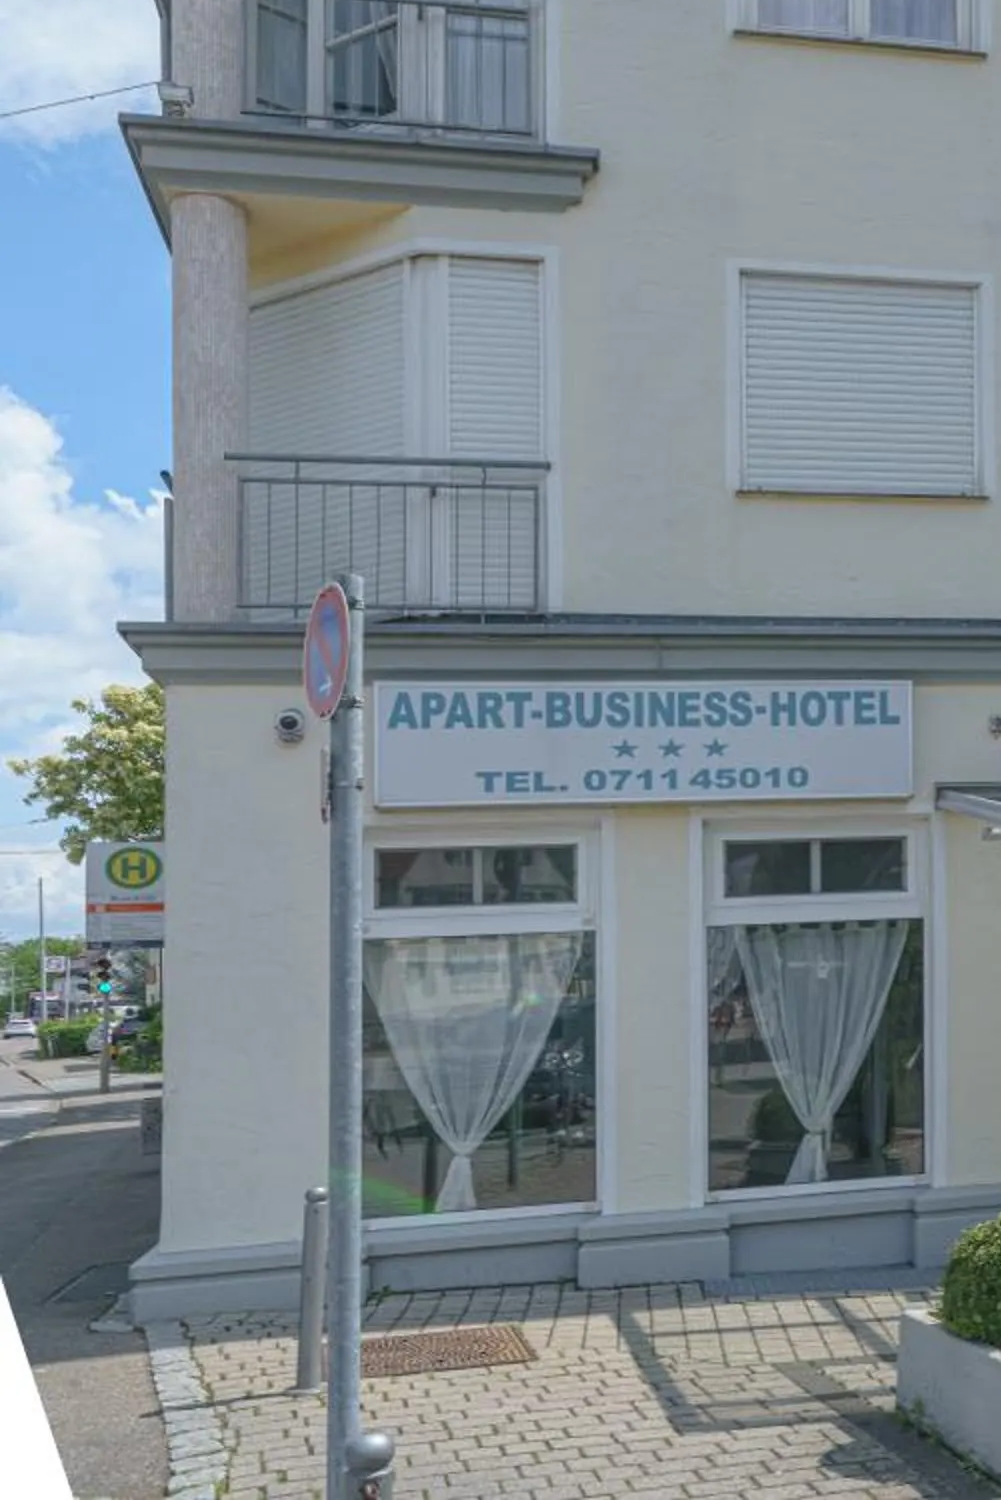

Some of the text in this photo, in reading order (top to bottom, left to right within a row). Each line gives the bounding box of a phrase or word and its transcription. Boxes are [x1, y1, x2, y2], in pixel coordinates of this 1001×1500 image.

[387, 689, 900, 730] APART-BUSINESS-HOTEL
[475, 771, 569, 793] TEL.
[121, 857, 148, 879] H
